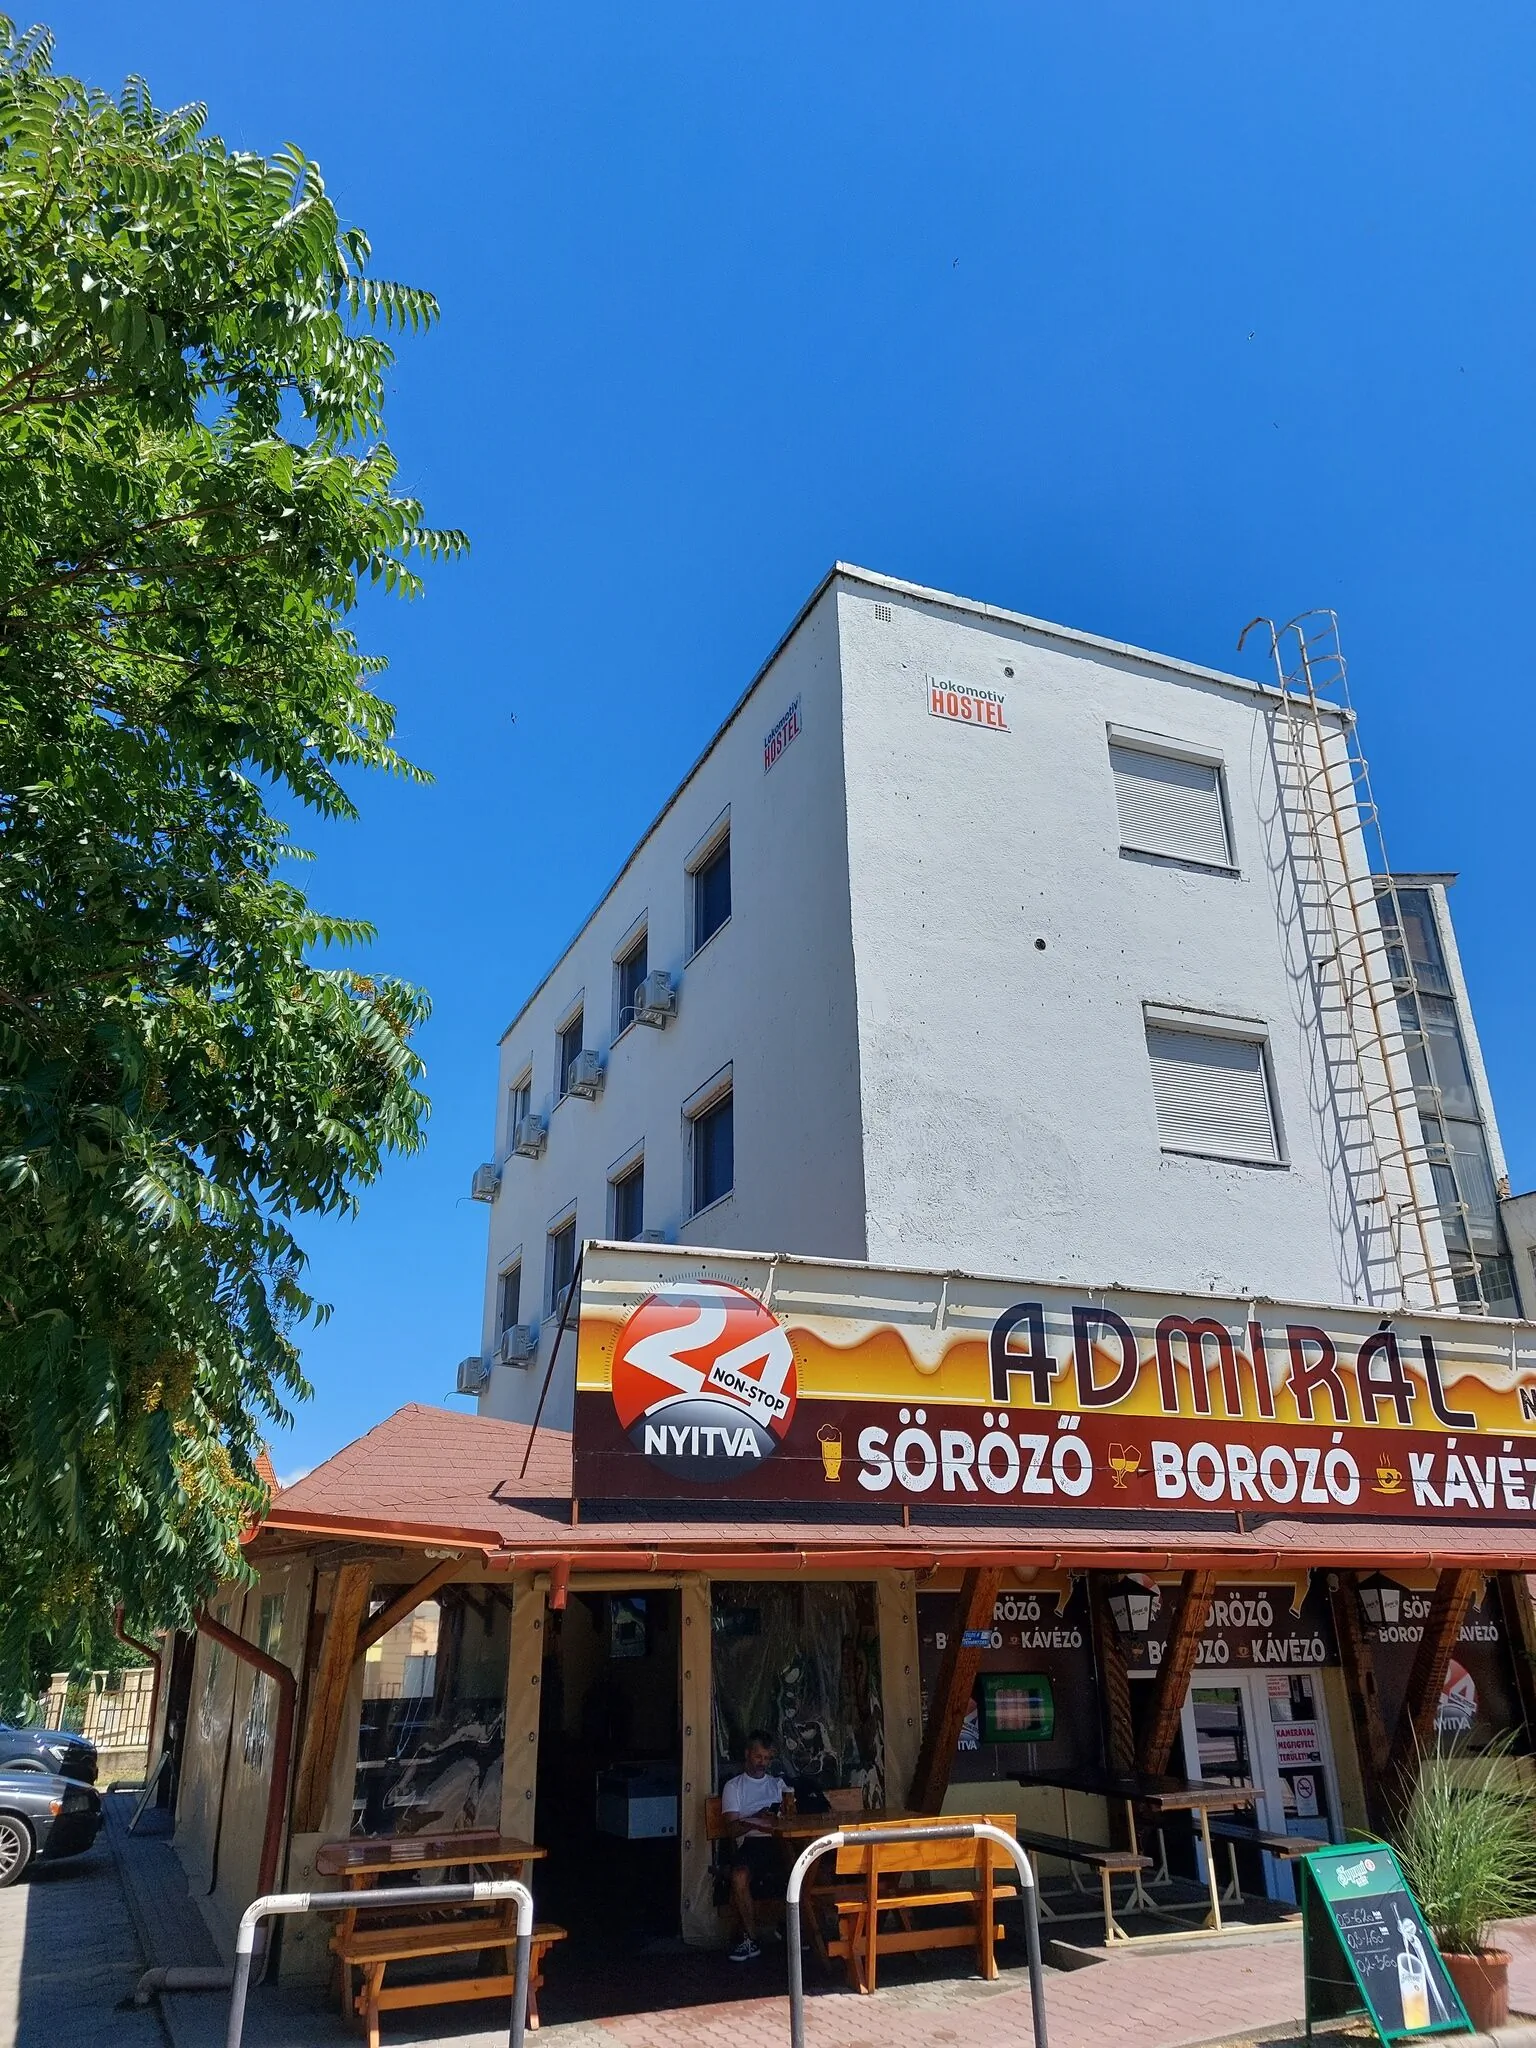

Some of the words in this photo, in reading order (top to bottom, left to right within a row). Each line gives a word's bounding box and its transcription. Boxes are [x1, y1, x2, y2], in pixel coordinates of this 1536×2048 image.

[931, 677, 1005, 704] Lokomotiv
[932, 688, 1008, 729] HOSTEL
[764, 699, 799, 749] Lokomotiv
[764, 712, 800, 771] HOSTEL
[623, 1281, 794, 1428] 24
[988, 1301, 1478, 1430] ADMIRÁL
[712, 1367, 785, 1411] NON-STOP
[644, 1425, 762, 1458] NYITVA
[857, 1408, 1093, 1497] SÖRÖZŐ
[1151, 1431, 1361, 1506] BOROZÓ
[993, 1595, 1041, 1621] RÖZŐ
[1204, 1591, 1274, 1627] RÖZŐ
[1021, 1626, 1083, 1649] KÁVÉZÓ
[1251, 1631, 1326, 1663] KÁVÉZÓ
[1433, 1716, 1472, 1731] NYITVA
[957, 1740, 978, 1751] ITVA
